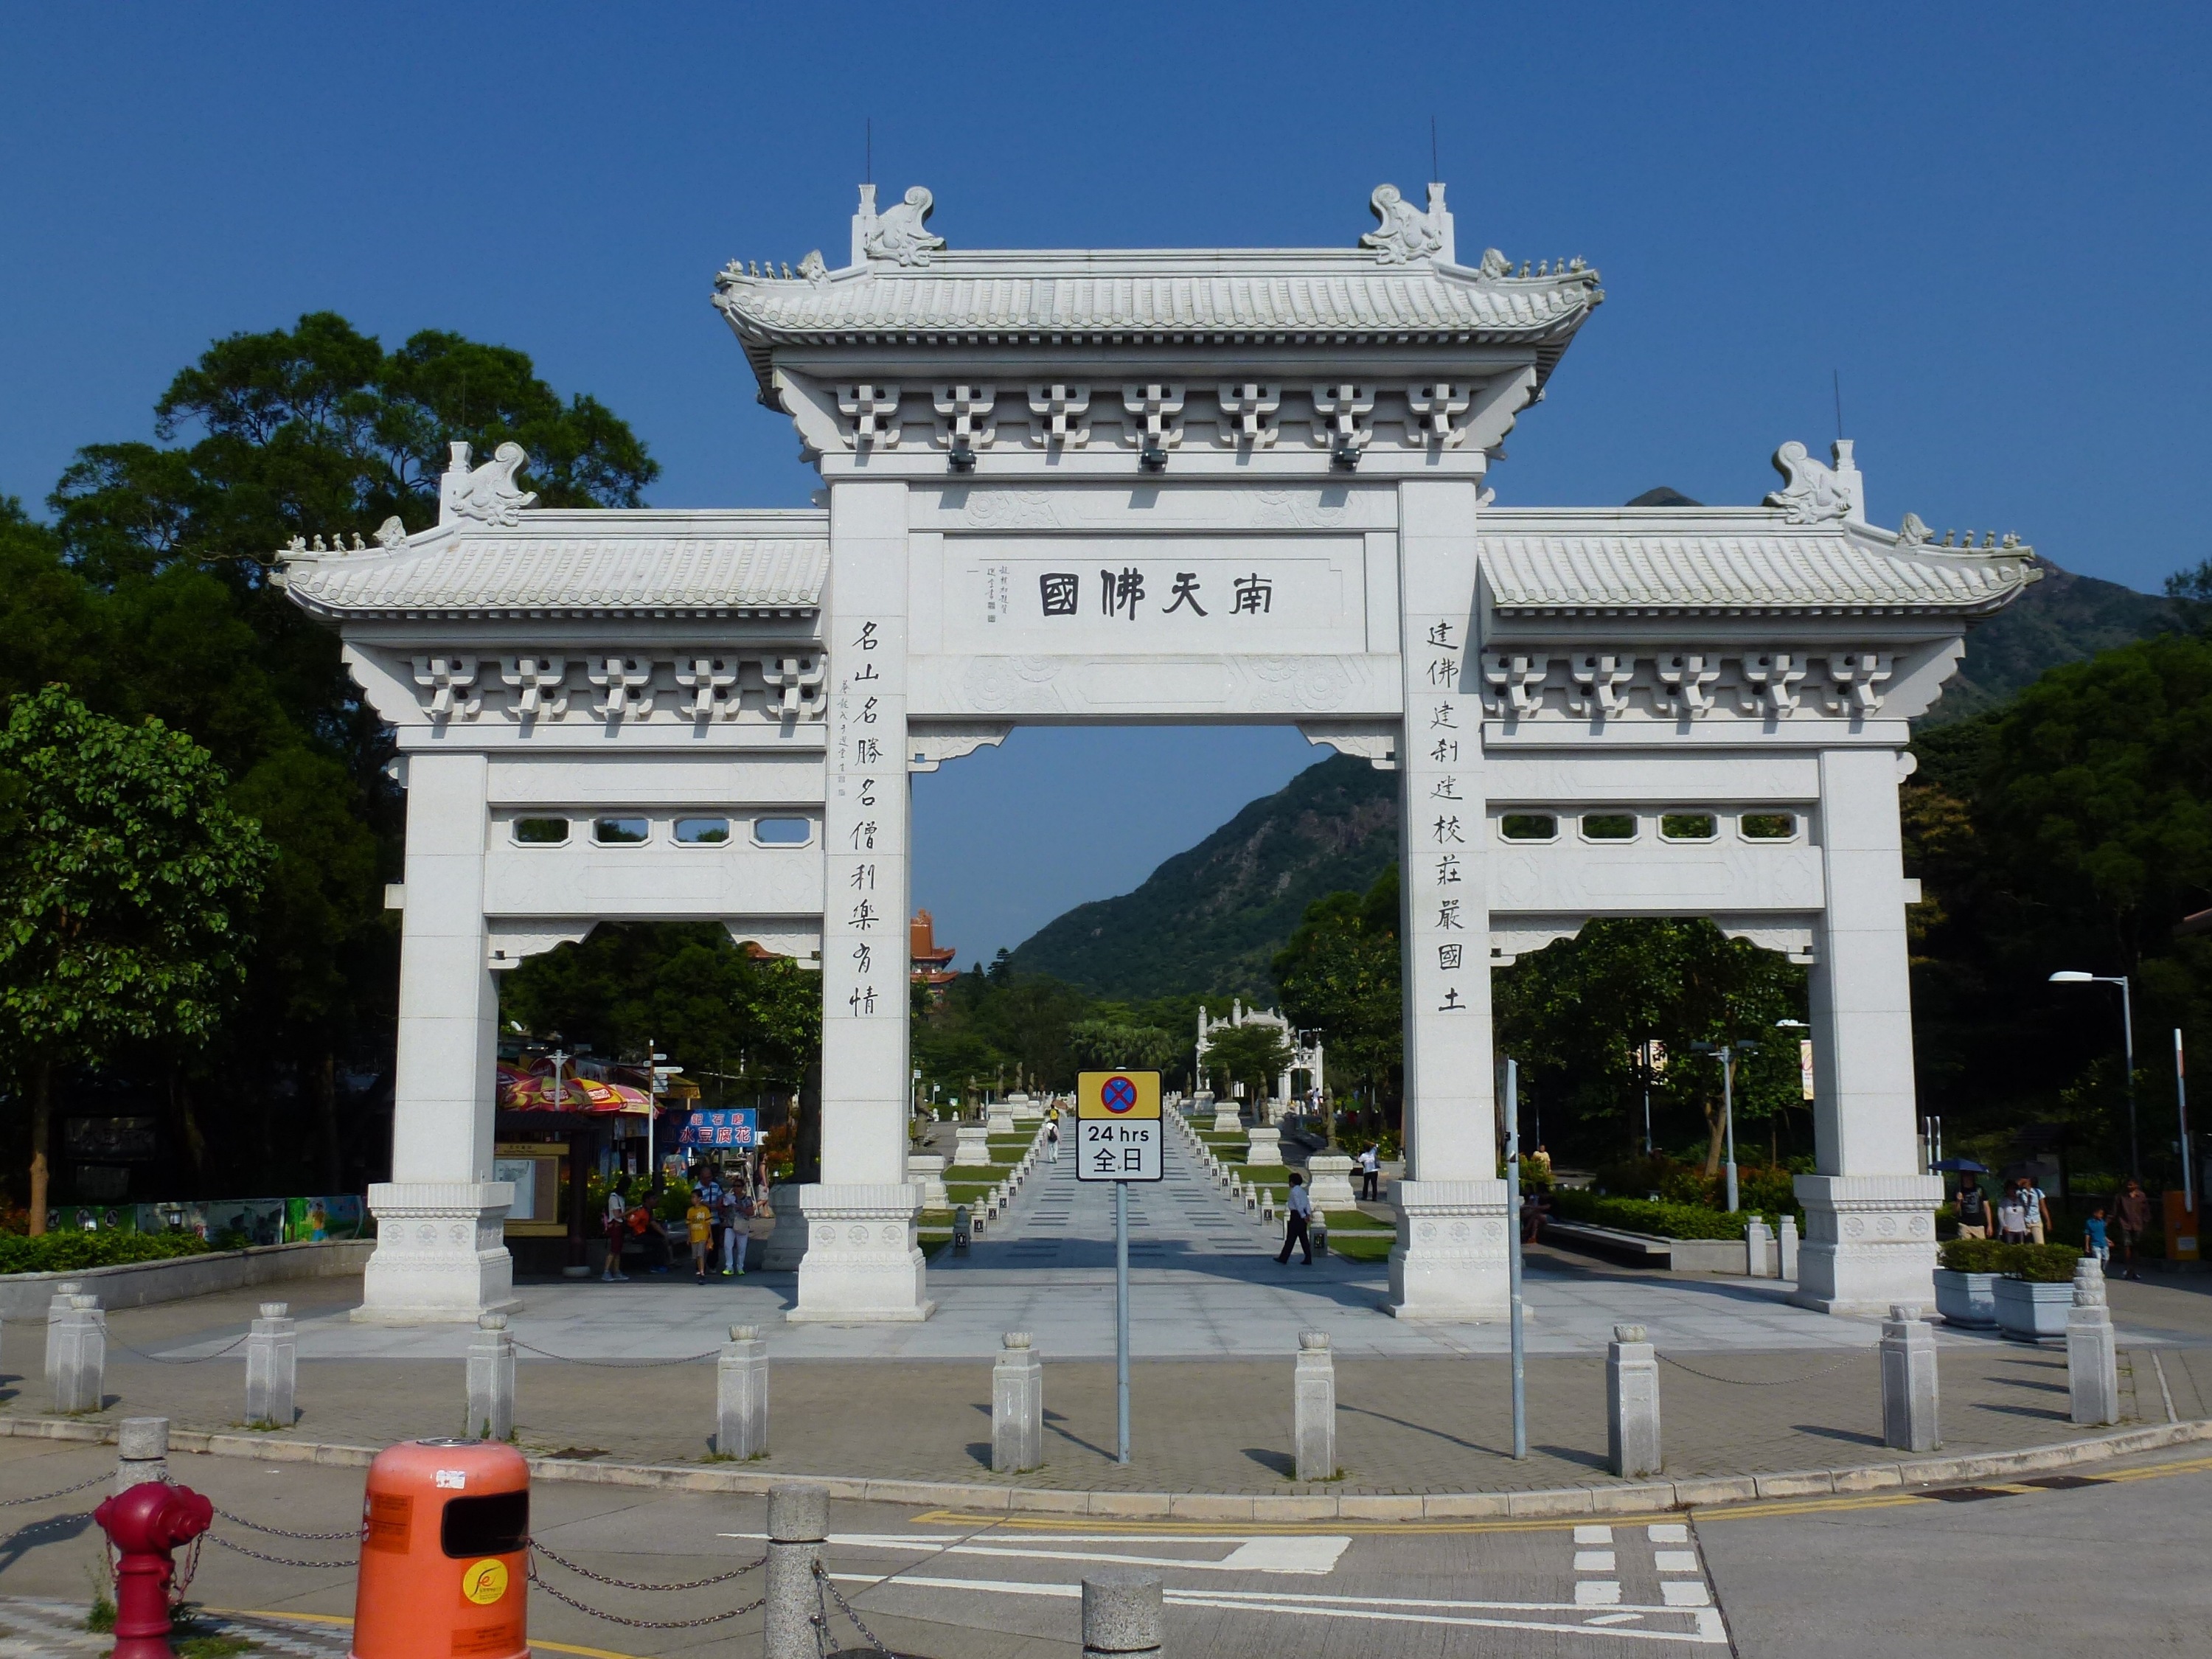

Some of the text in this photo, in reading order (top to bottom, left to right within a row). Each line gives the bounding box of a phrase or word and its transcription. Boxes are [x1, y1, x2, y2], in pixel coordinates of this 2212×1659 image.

[662, 1125, 751, 1144] 山水豆腐花
[1088, 1126, 1150, 1142] 24 hrs
[1093, 1147, 1141, 1172] 全日
